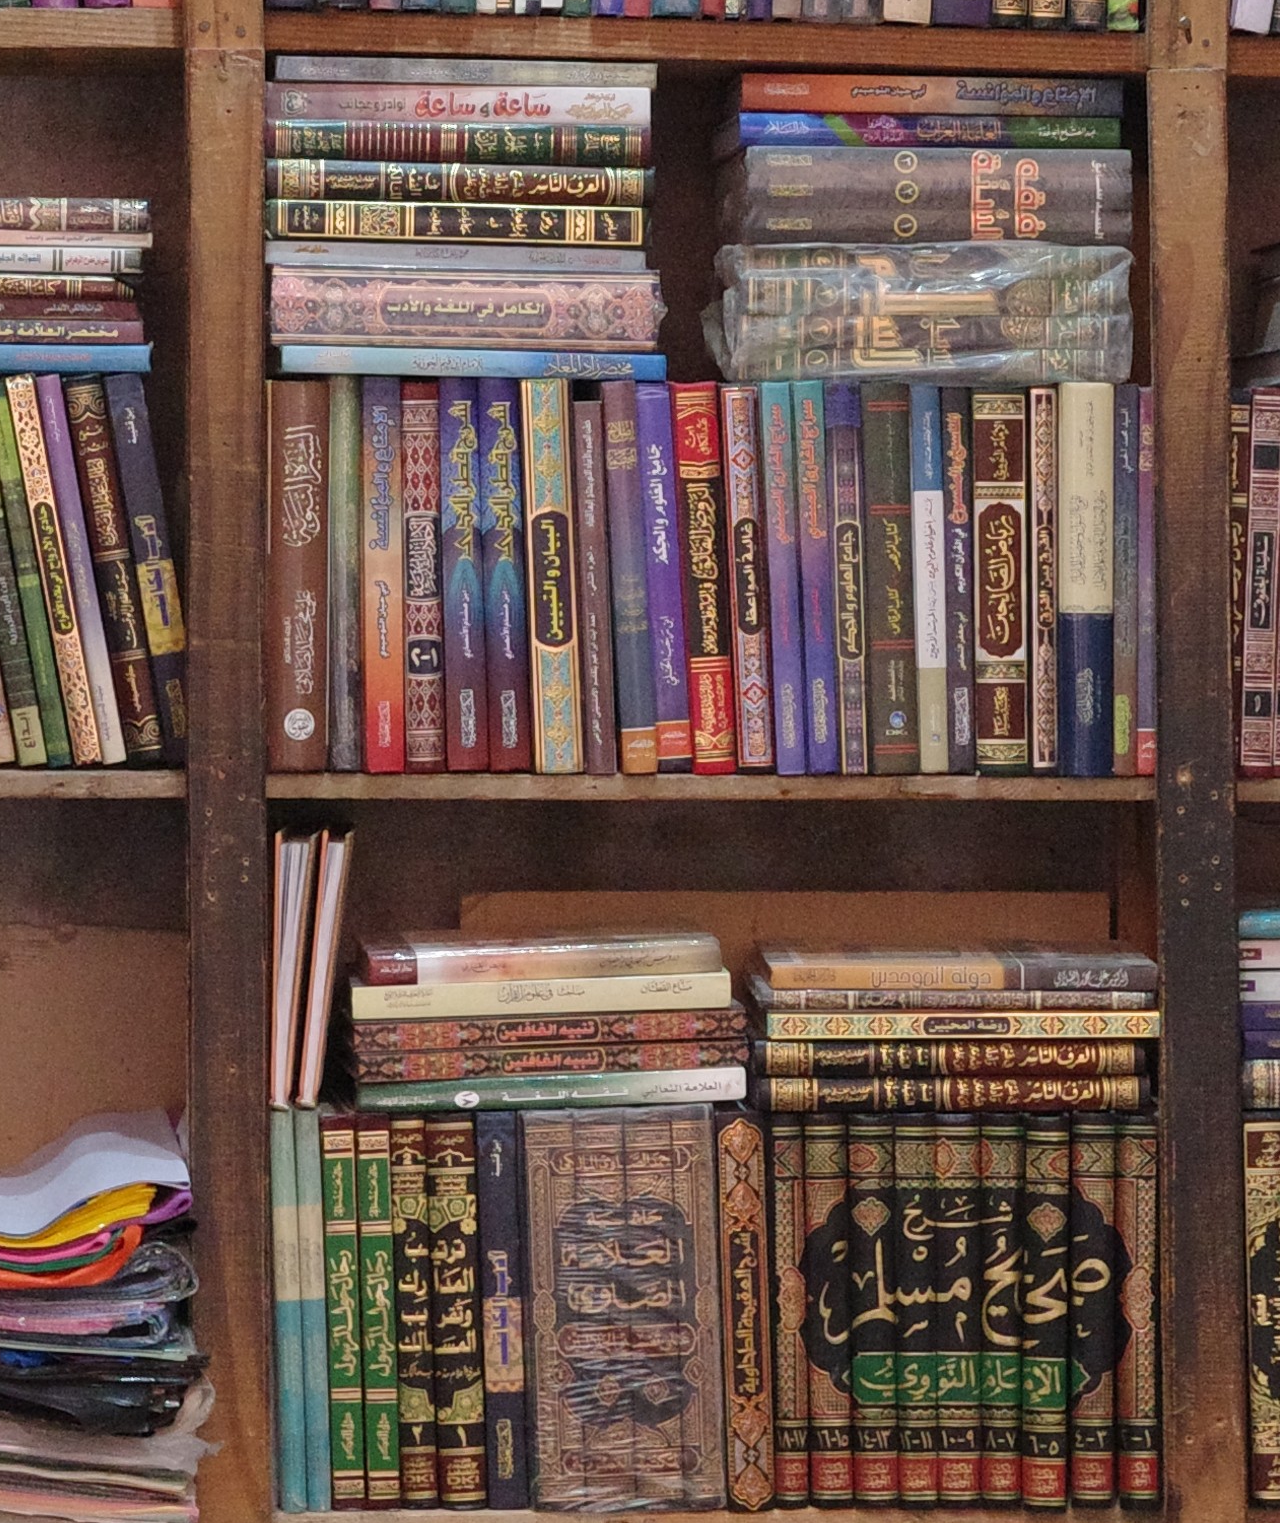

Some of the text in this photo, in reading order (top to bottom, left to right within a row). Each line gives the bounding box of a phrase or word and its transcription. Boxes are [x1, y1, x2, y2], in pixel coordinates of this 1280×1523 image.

[415, 93, 476, 119] ساعة
[501, 94, 551, 119] ساعة
[540, 519, 560, 566] البيان
[542, 579, 564, 640] التبيين
[556, 1018, 596, 1039] تنبيه
[732, 1267, 761, 1325] العقيدة
[734, 1327, 760, 1393] الطحاوية
